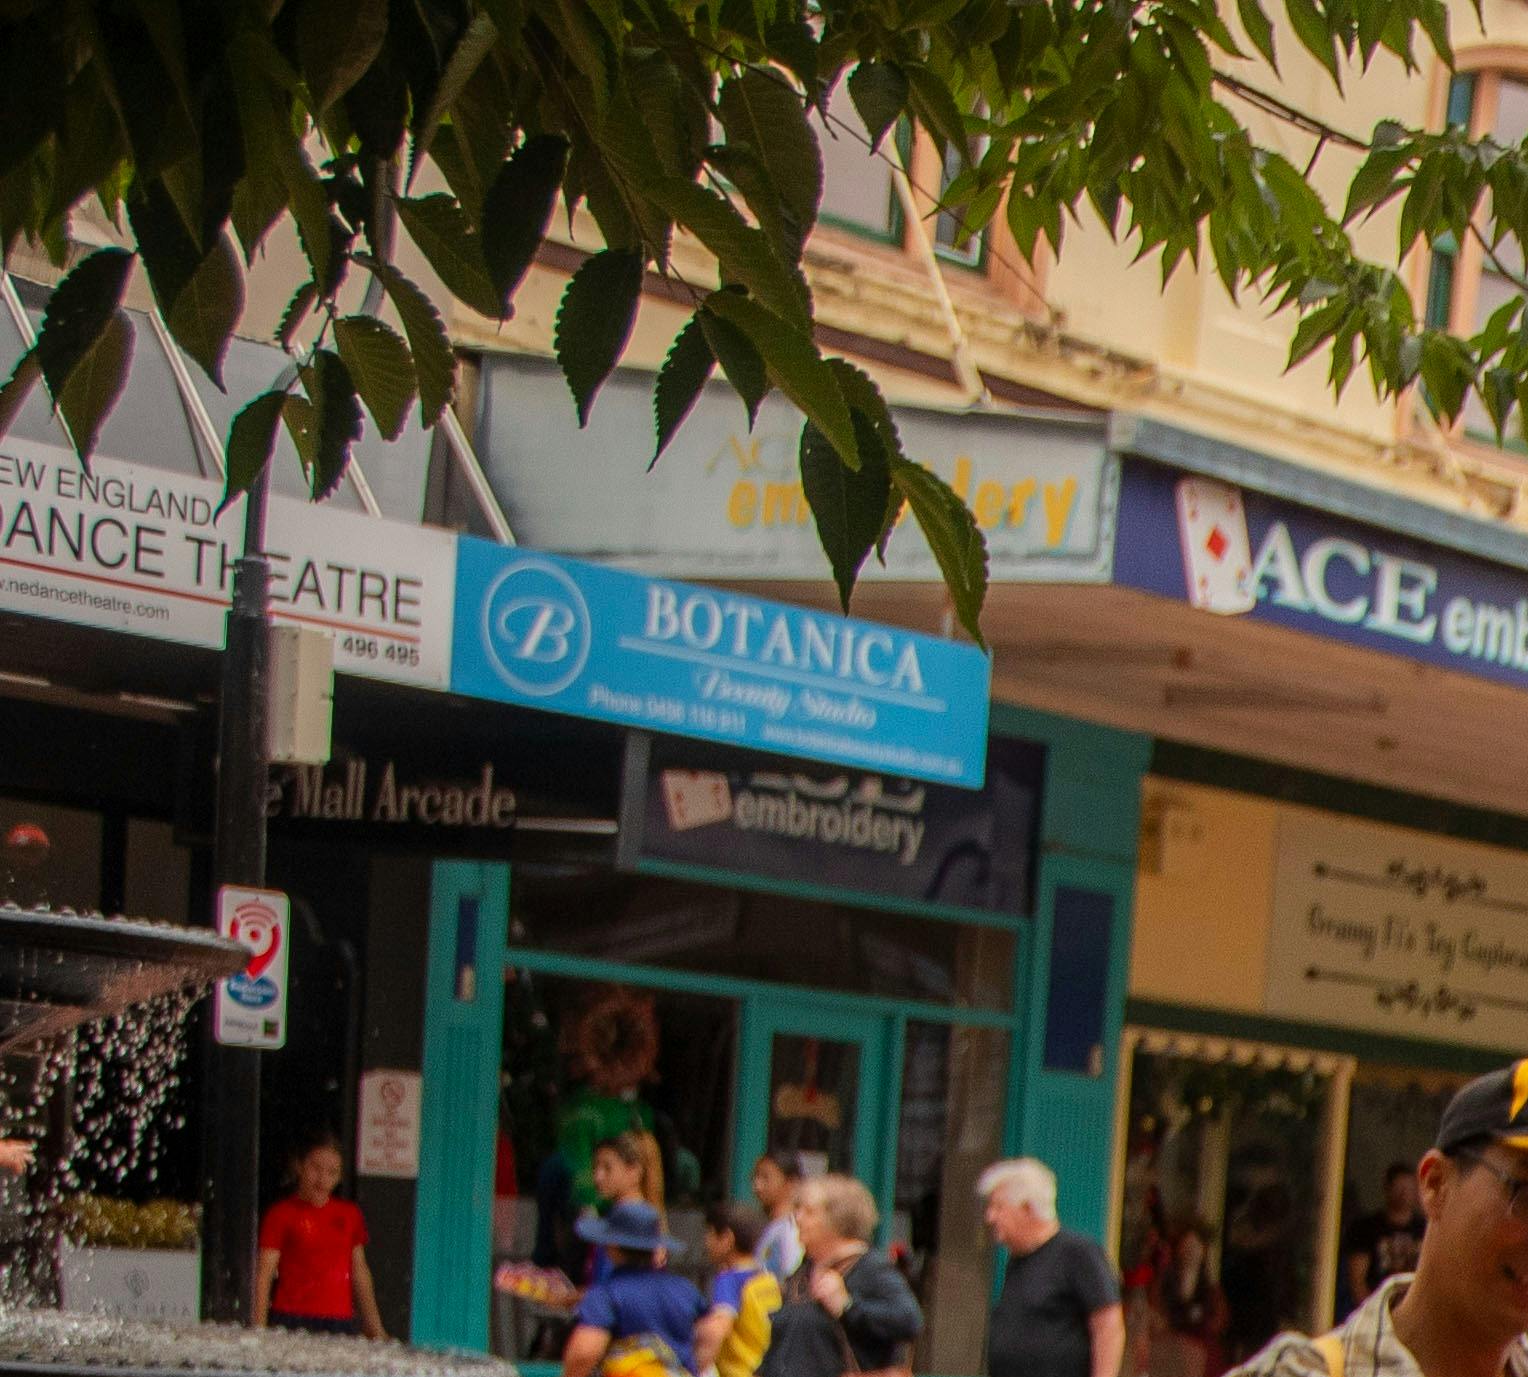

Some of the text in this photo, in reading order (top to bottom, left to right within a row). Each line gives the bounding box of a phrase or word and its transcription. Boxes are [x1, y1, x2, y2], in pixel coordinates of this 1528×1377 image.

[57, 468, 212, 527] ENGLAND
[0, 500, 166, 578] ANCE
[1247, 521, 1438, 644] ACE
[343, 636, 421, 668] 496 495
[645, 583, 925, 692] BOTANICA
[293, 757, 367, 820] Mall
[373, 761, 517, 828] Arcade
[735, 790, 925, 867] embroidery
